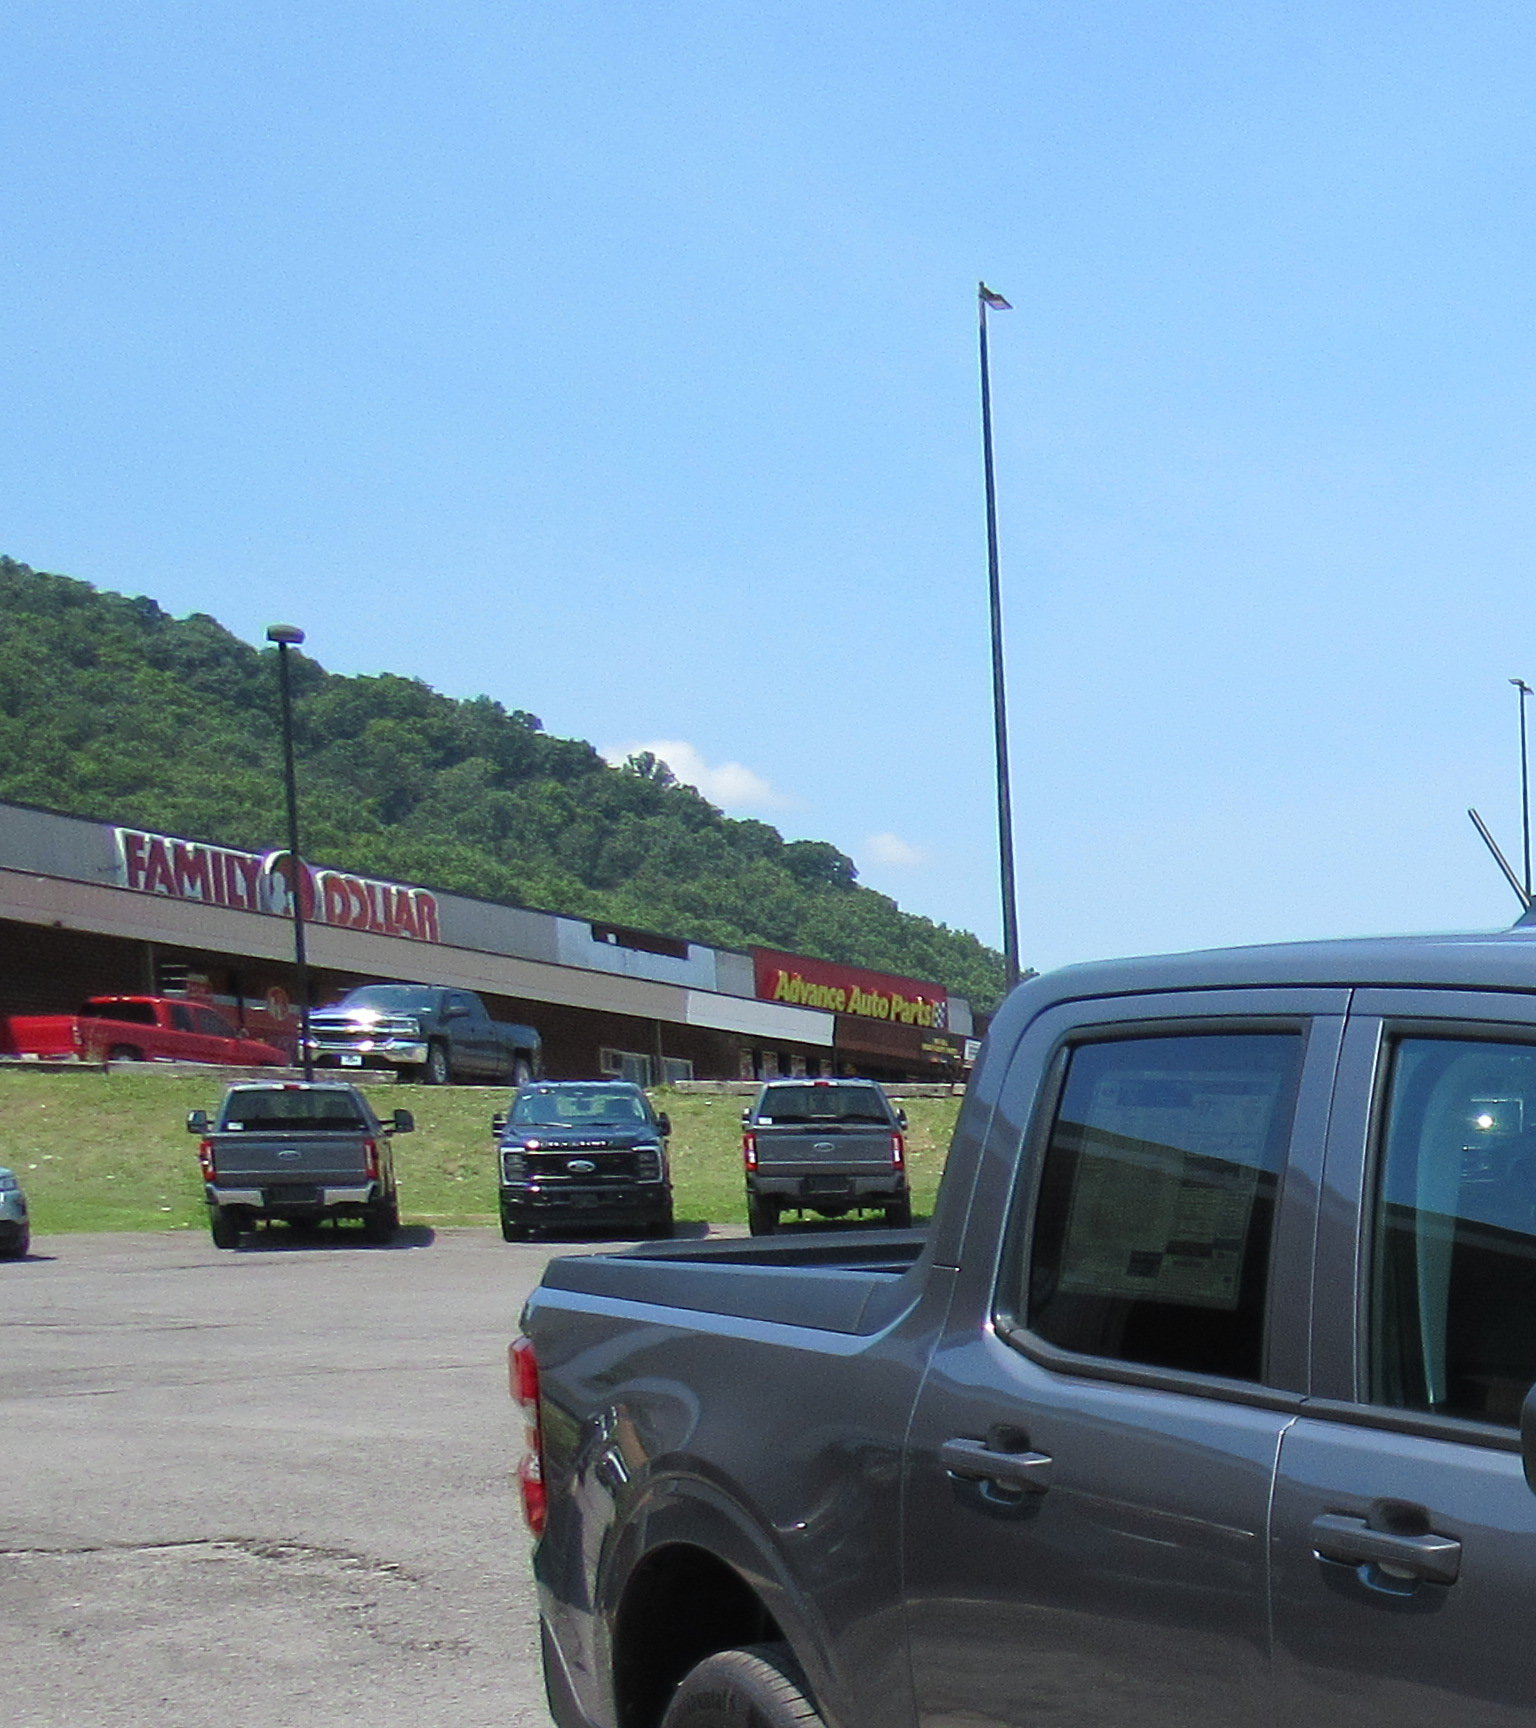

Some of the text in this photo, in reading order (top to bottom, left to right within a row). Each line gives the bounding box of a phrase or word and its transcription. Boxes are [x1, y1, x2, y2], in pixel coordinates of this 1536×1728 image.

[116, 827, 442, 943] FAMILY DOLLAR
[773, 969, 933, 1028] Advance Auto Parts
